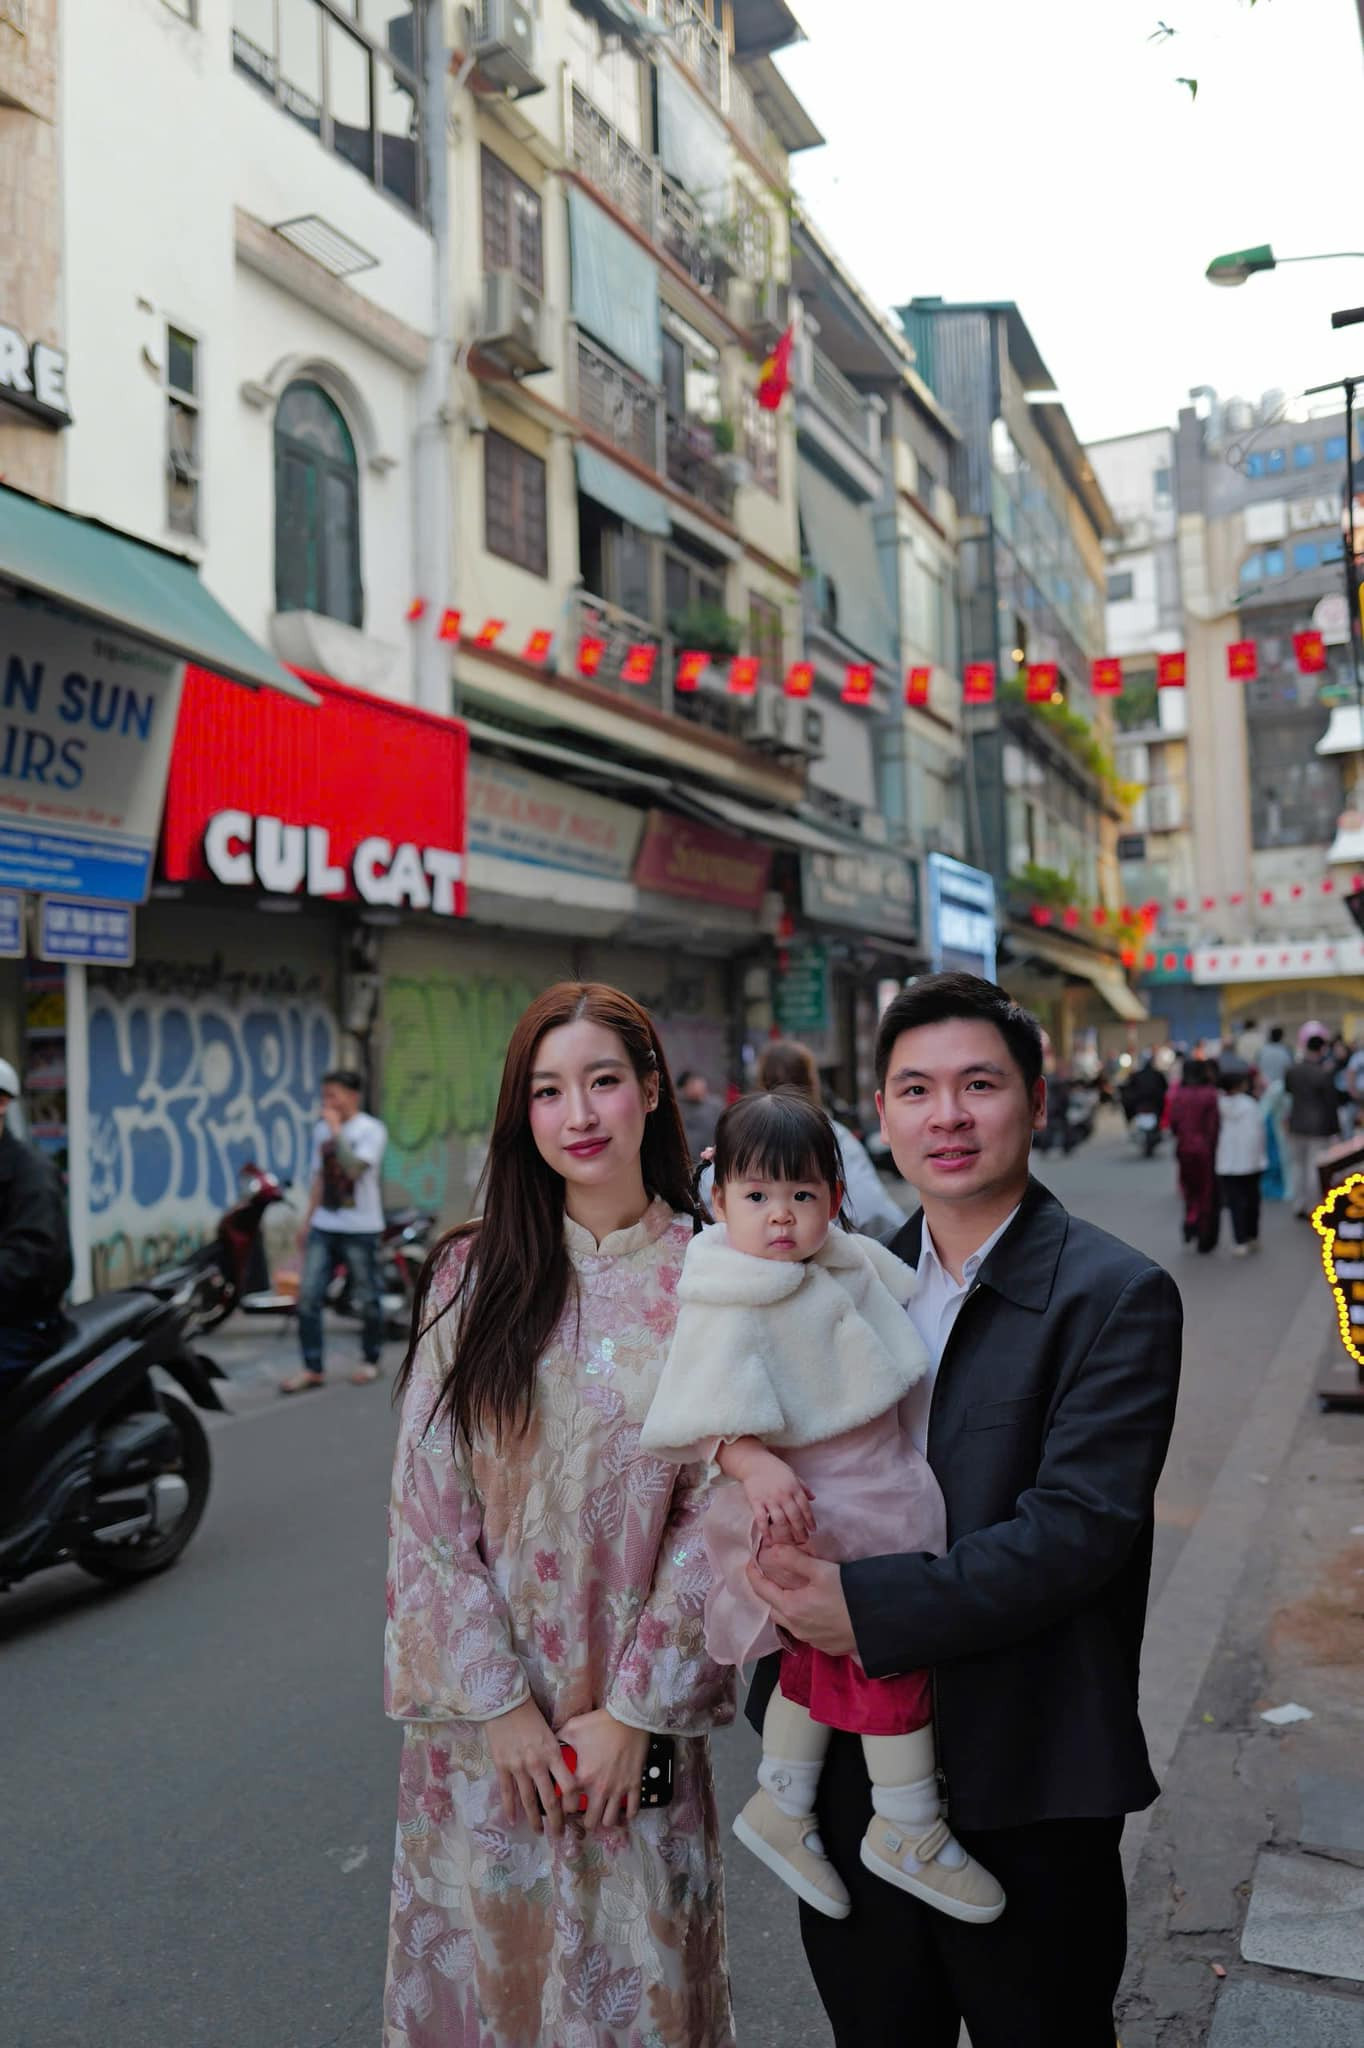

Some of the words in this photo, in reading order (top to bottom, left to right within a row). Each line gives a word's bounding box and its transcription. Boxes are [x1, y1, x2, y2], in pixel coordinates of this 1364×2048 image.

[58, 671, 154, 742] SUN
[0, 725, 87, 790] IRS
[204, 809, 346, 897] CUL
[353, 836, 462, 916] CAT
